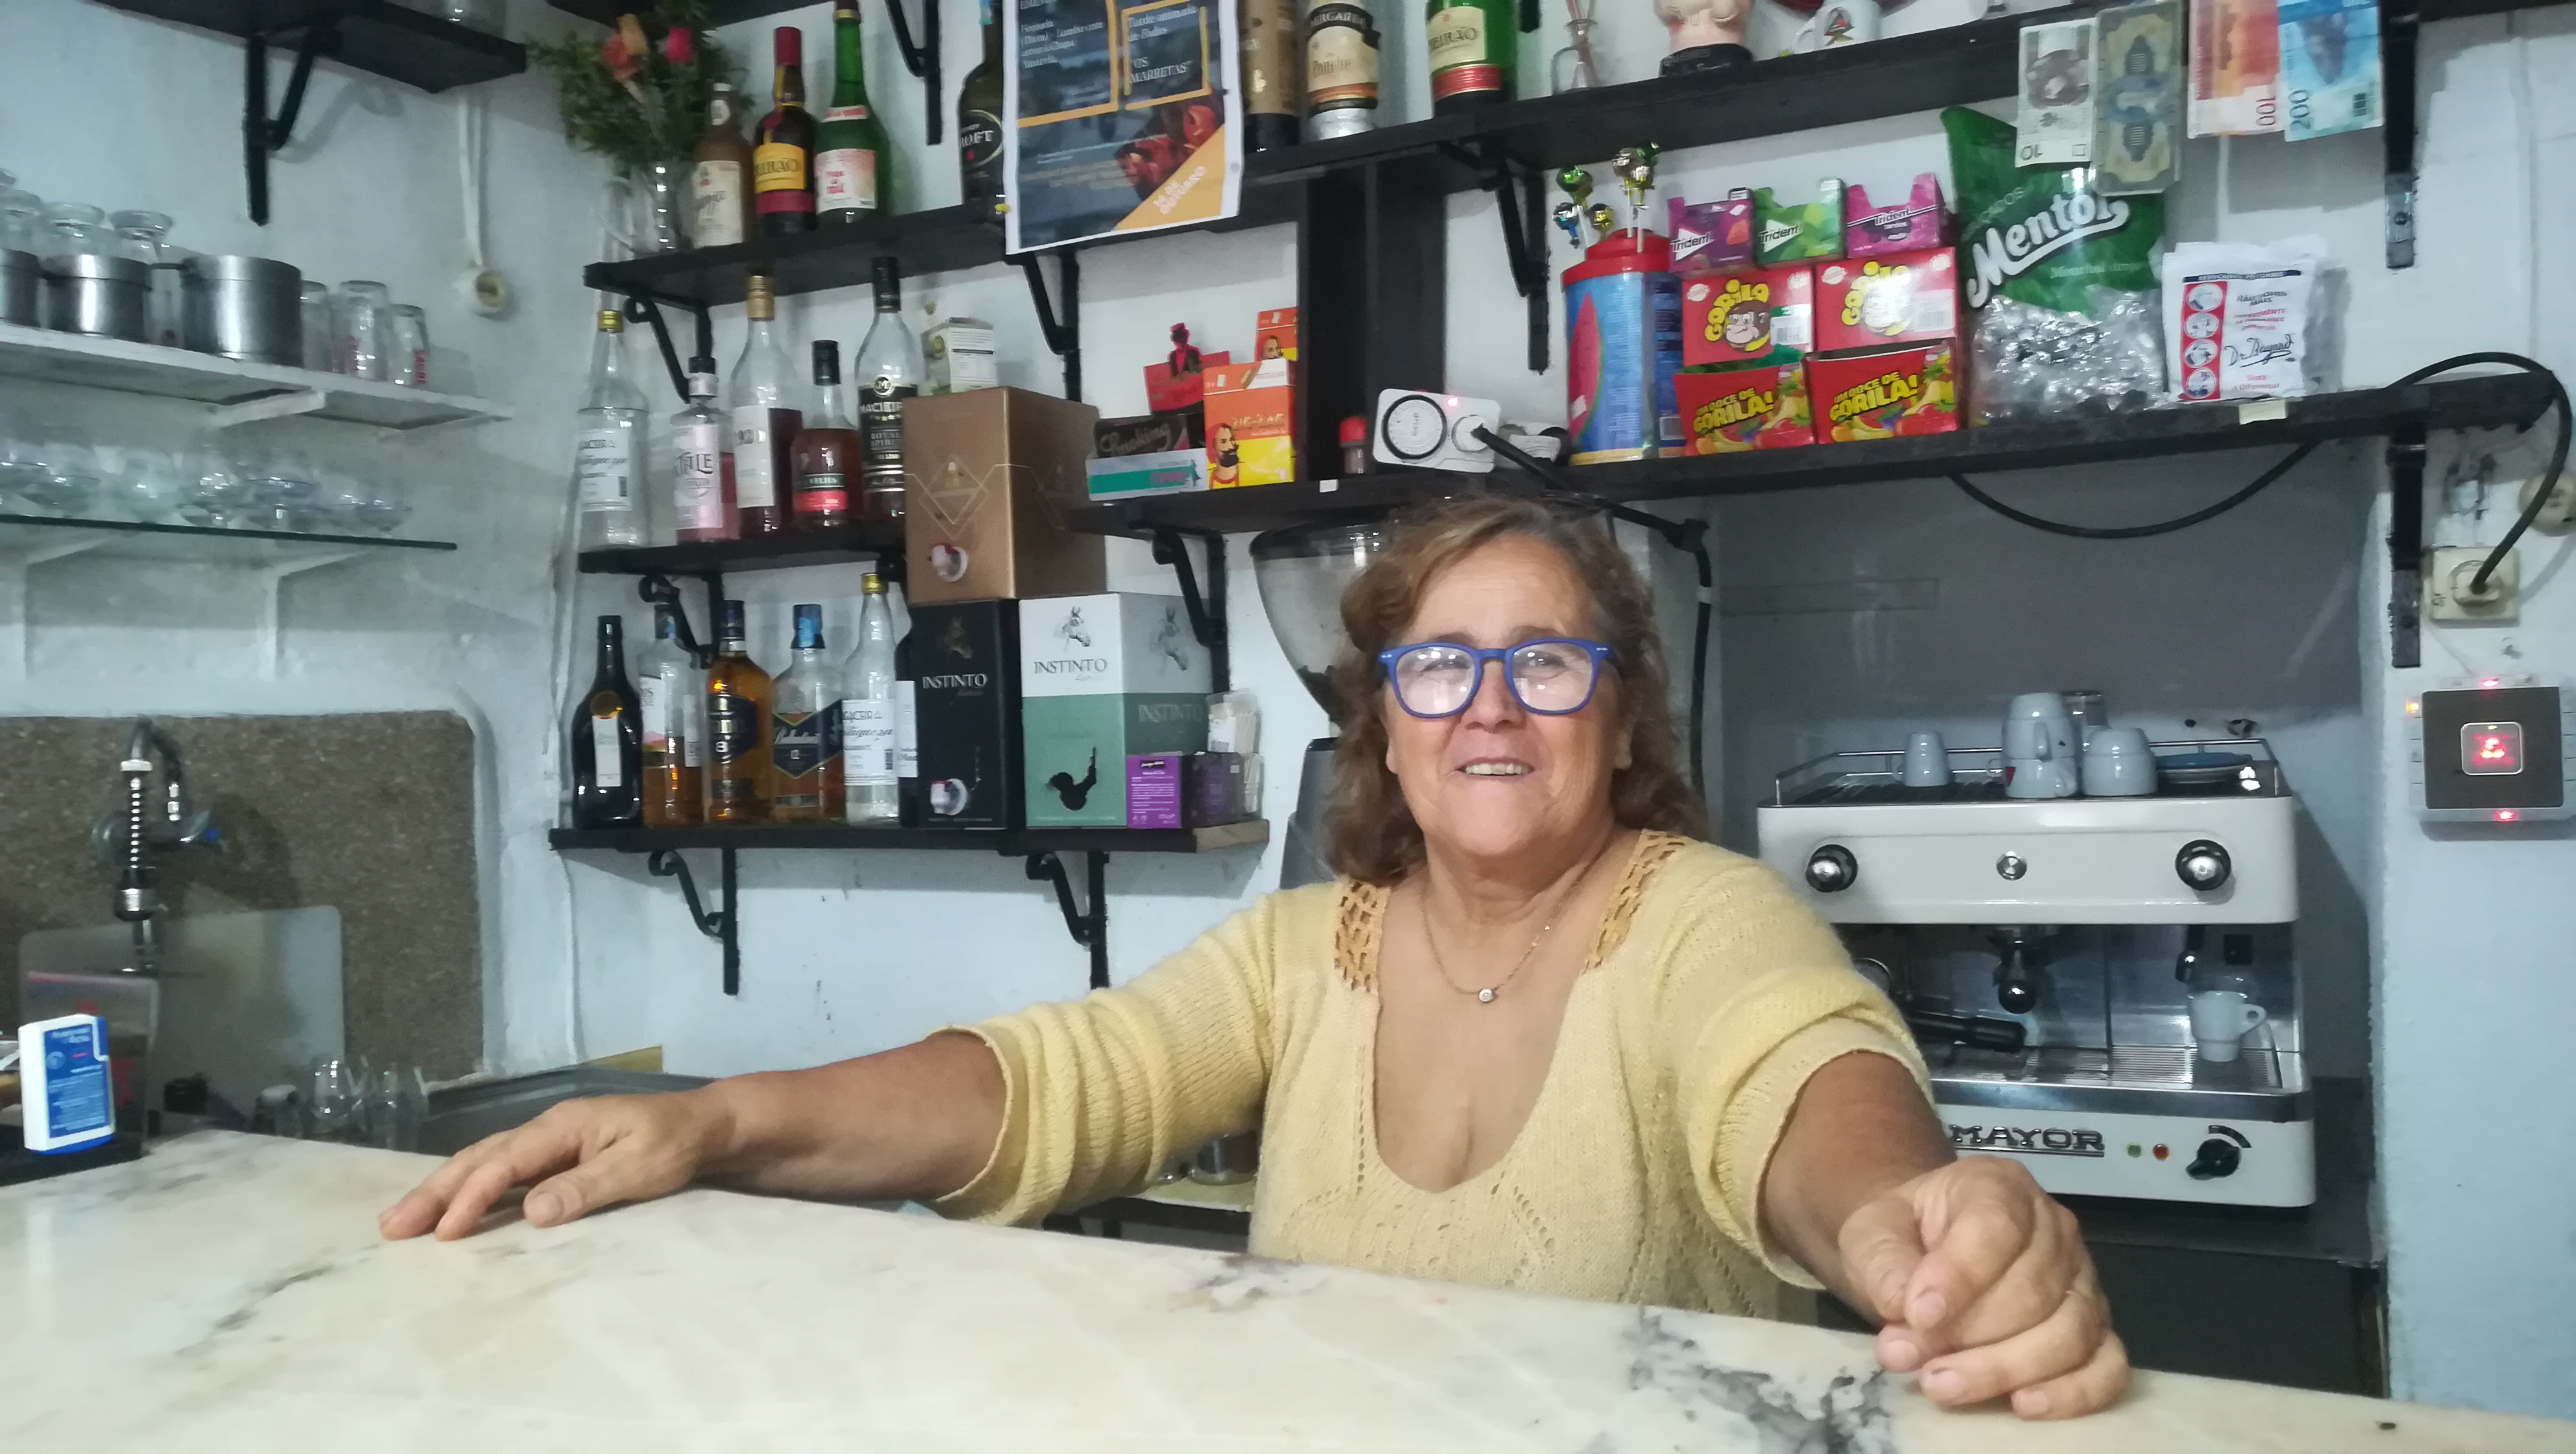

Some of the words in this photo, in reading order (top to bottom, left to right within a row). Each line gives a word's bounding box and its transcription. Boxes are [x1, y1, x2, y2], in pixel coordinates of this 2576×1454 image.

[1874, 206, 1912, 226] Trident
[1670, 231, 1713, 253] Trident
[1759, 222, 1802, 245] Trident
[1849, 378, 1881, 396] DOCE
[1881, 371, 1901, 385] DE
[1709, 393, 1738, 410] DOCE
[1738, 388, 1756, 400] DE
[1829, 374, 1918, 421] GORILA!
[1693, 391, 1774, 433] GORILA!
[1034, 658, 1108, 674] INSTINTO
[923, 673, 989, 689] INSTINTO
[1138, 703, 1202, 723] INSTINTO
[1948, 1123, 2105, 1152] MAYOR
